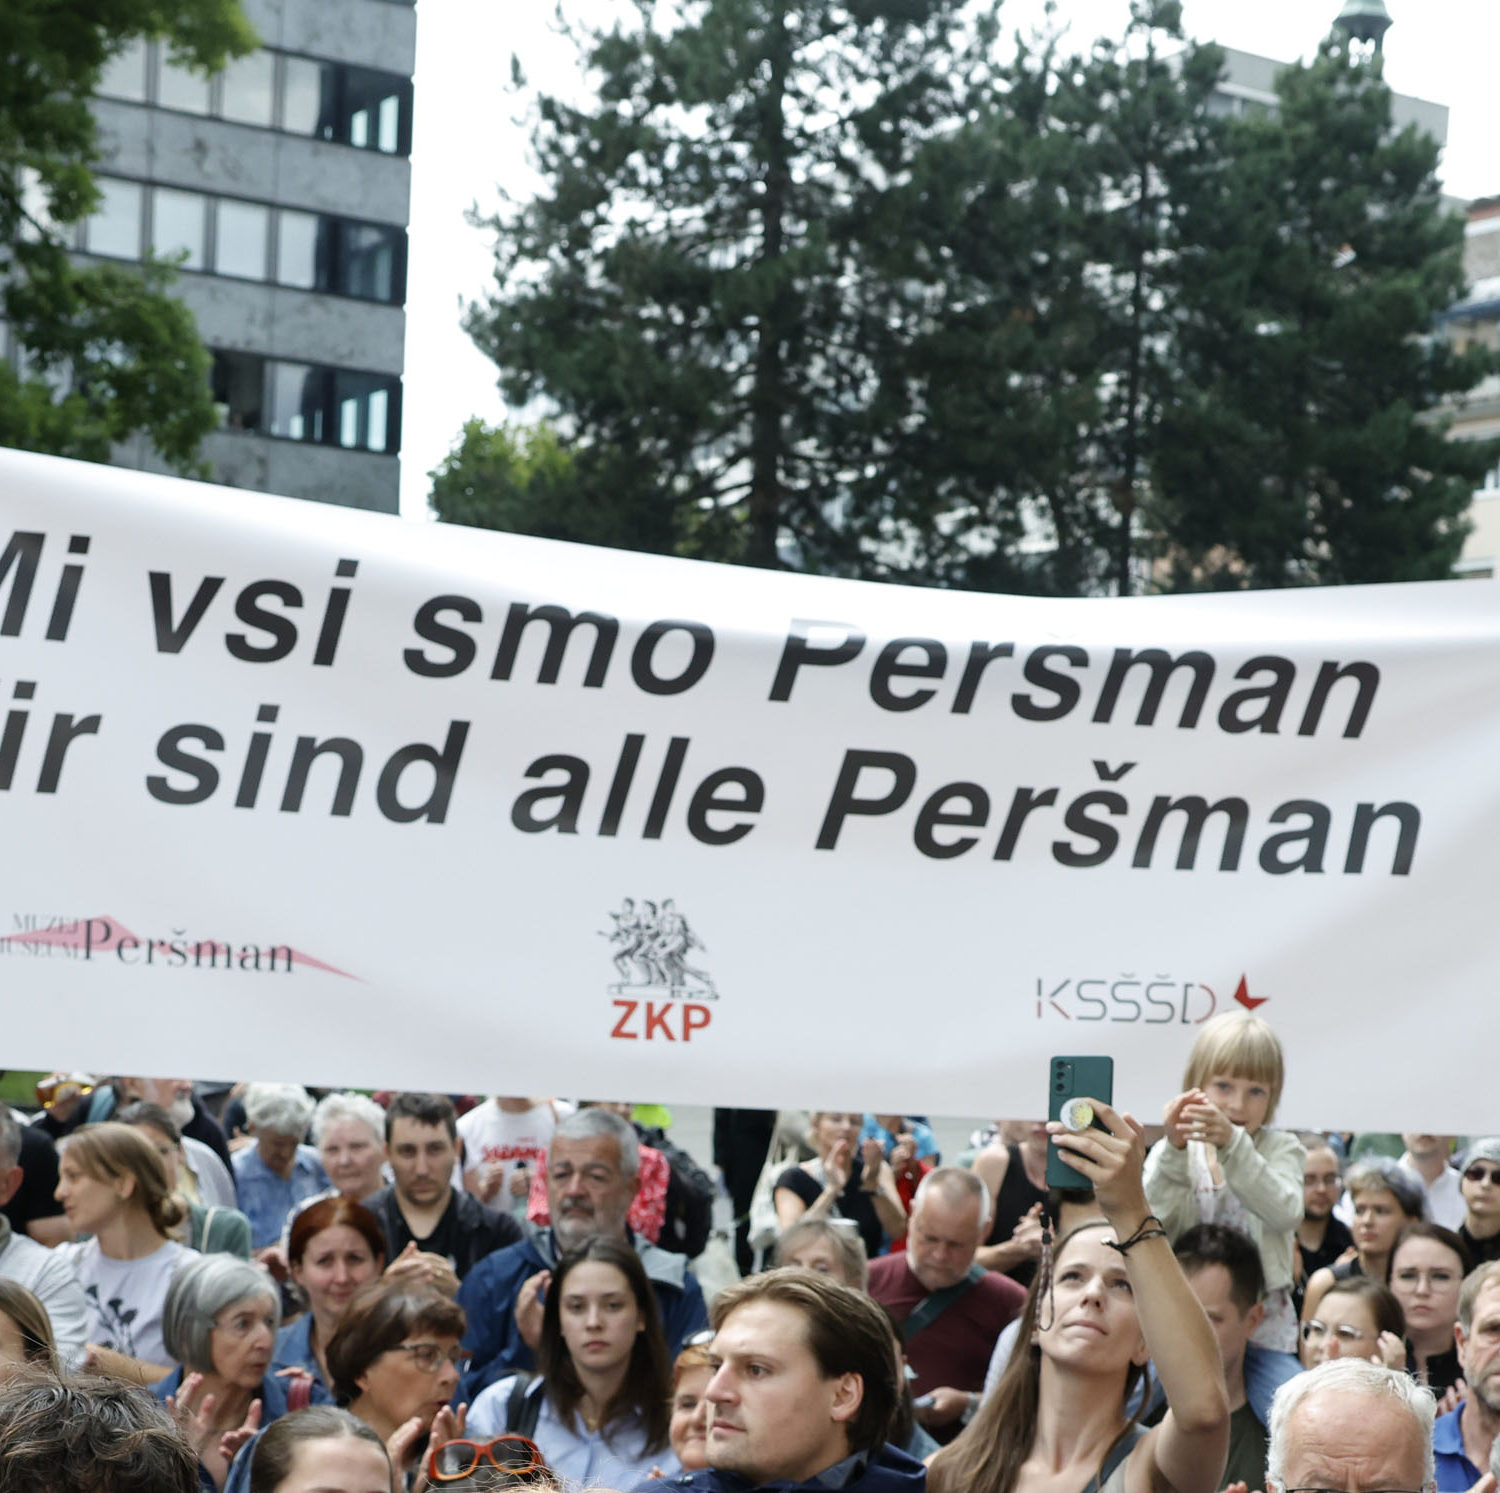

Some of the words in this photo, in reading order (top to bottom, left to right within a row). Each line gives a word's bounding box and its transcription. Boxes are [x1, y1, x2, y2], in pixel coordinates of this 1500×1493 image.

[148, 560, 359, 667] vsi
[404, 594, 715, 697] smo
[146, 705, 471, 825] sind
[510, 733, 766, 847] alle
[815, 748, 1422, 877] Peršman
[82, 917, 296, 973] Peršman
[611, 1001, 713, 1041] ZKP
